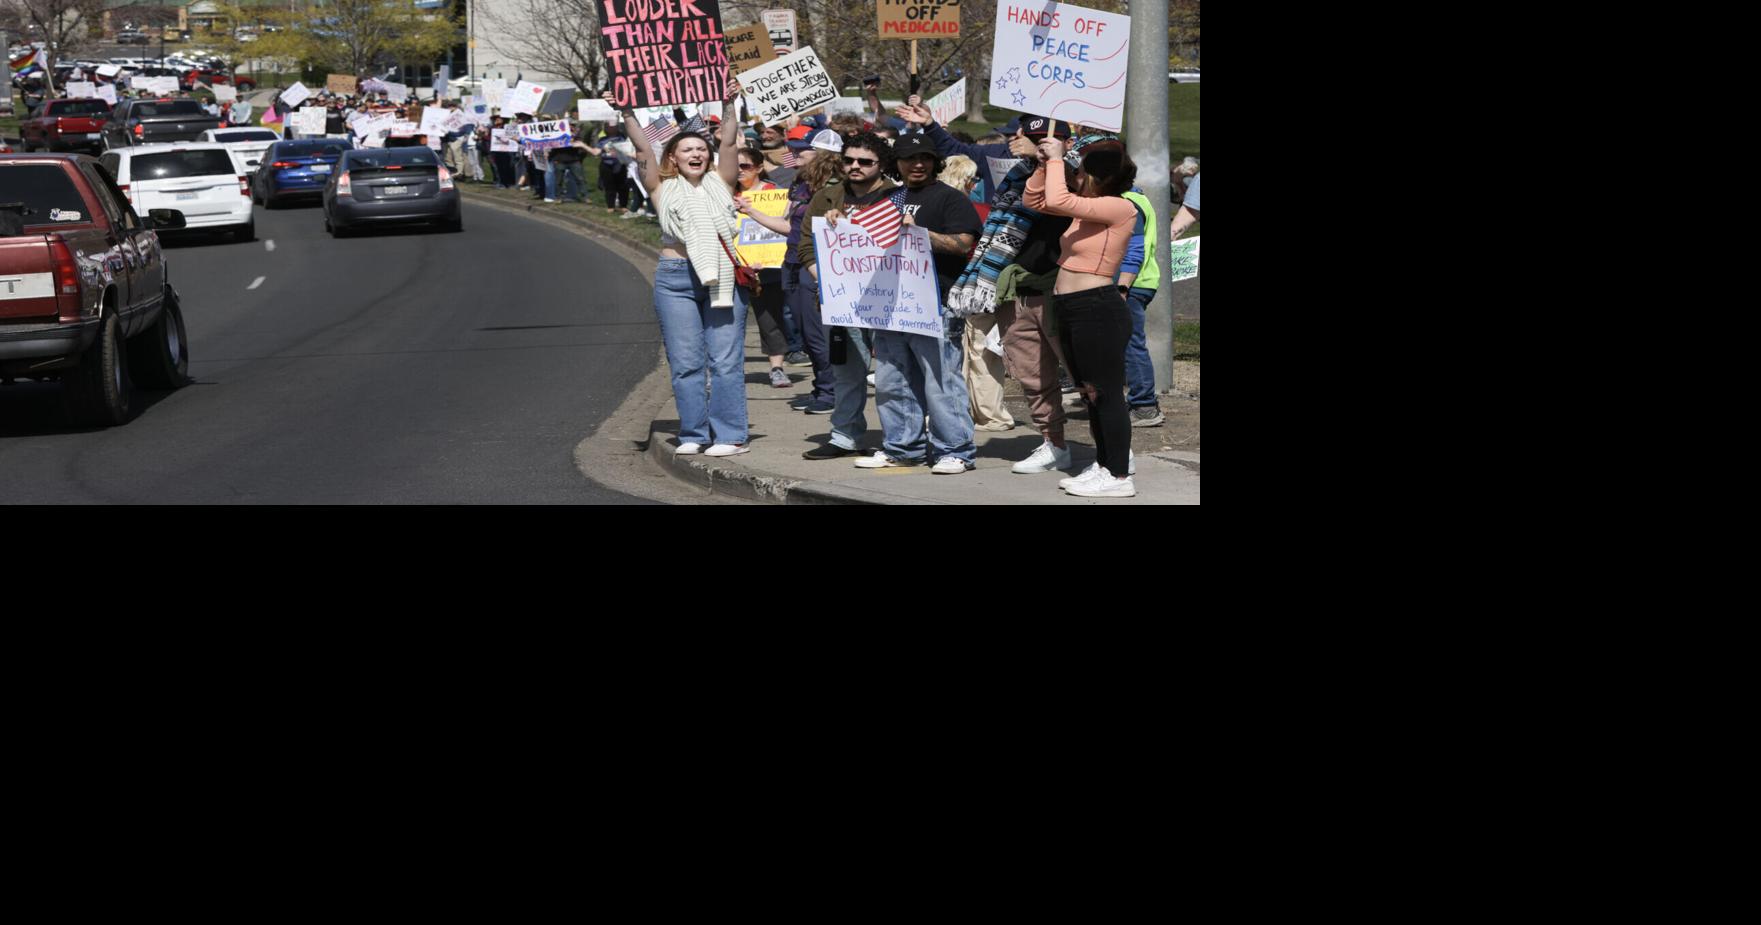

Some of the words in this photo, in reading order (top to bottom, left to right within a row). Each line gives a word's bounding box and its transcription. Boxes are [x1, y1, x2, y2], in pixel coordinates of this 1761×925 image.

[604, 0, 706, 24] LOUDER
[906, 6, 942, 20] OFF
[1007, 6, 1060, 28] HANDS
[1074, 18, 1107, 37] OFF
[602, 20, 674, 49] THAN
[681, 18, 723, 41] ALL
[606, 43, 679, 73] THEIR
[680, 40, 730, 68] LACK
[1032, 34, 1090, 62] PEACE
[615, 74, 638, 107] OF
[643, 65, 730, 106] EMPATHY
[750, 55, 817, 92] TOGETHER
[1027, 60, 1086, 89] CORPS
[757, 90, 778, 103] WE
[780, 81, 797, 95] ARE
[752, 192, 788, 202] TRUM
[823, 228, 880, 248] DEFEN
[901, 233, 925, 253] THE
[828, 282, 846, 298] Let
[858, 282, 894, 304] history
[901, 284, 915, 300] be
[830, 313, 853, 324] avoid
[860, 315, 893, 328] corrupt
[883, 303, 911, 318] guide
[915, 303, 923, 314] to
